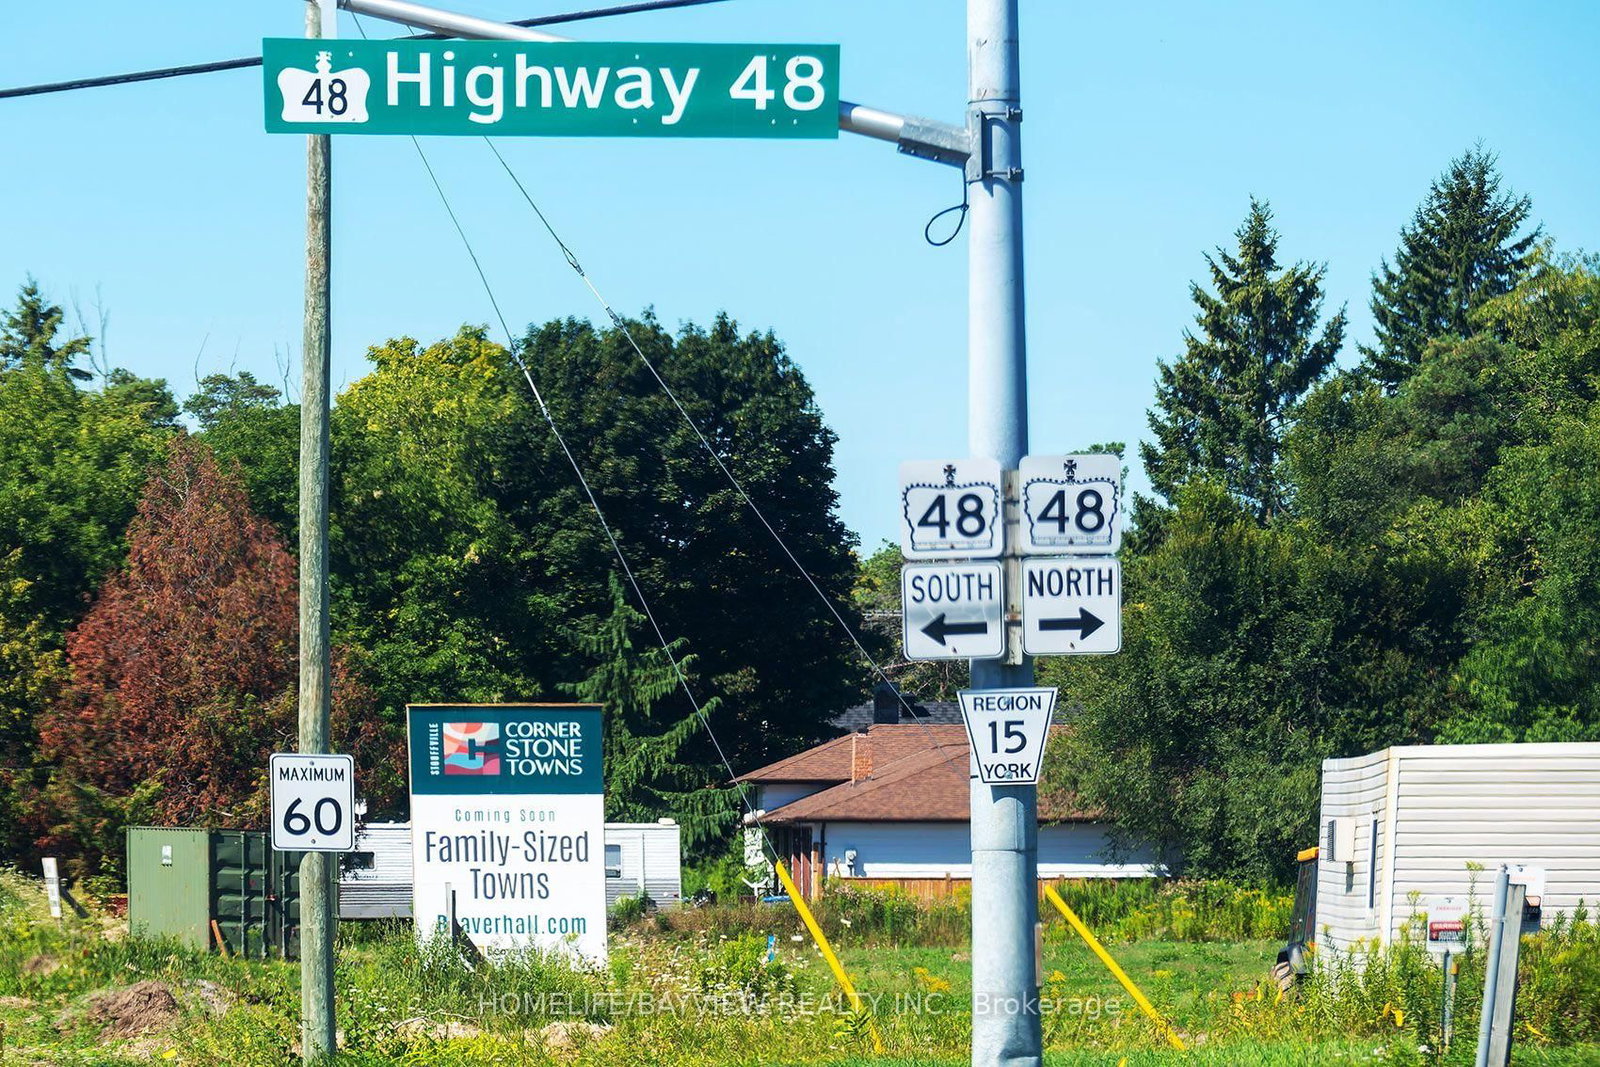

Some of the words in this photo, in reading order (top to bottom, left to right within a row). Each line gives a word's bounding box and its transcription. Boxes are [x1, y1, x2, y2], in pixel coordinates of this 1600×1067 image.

[301, 79, 349, 115] 48
[386, 51, 700, 125] Highway
[728, 55, 826, 112] 48
[917, 494, 986, 539] 48
[1037, 489, 1105, 534] 48
[911, 573, 993, 603] SOUTH
[1028, 568, 1114, 597] NORTH
[973, 696, 1042, 711] REGION
[505, 722, 581, 738] CORNER
[988, 720, 1028, 754] 15
[505, 739, 583, 758] STONE
[279, 767, 344, 781] MAXIMUM
[505, 759, 583, 776] TOWNS
[984, 763, 1032, 779] YORK
[283, 797, 342, 836] 60
[455, 809, 511, 823] Coming
[520, 809, 556, 822] Soon
[426, 830, 589, 866] Family-Sized
[470, 868, 549, 899] Towns
[437, 915, 587, 935] Baverhall.com
